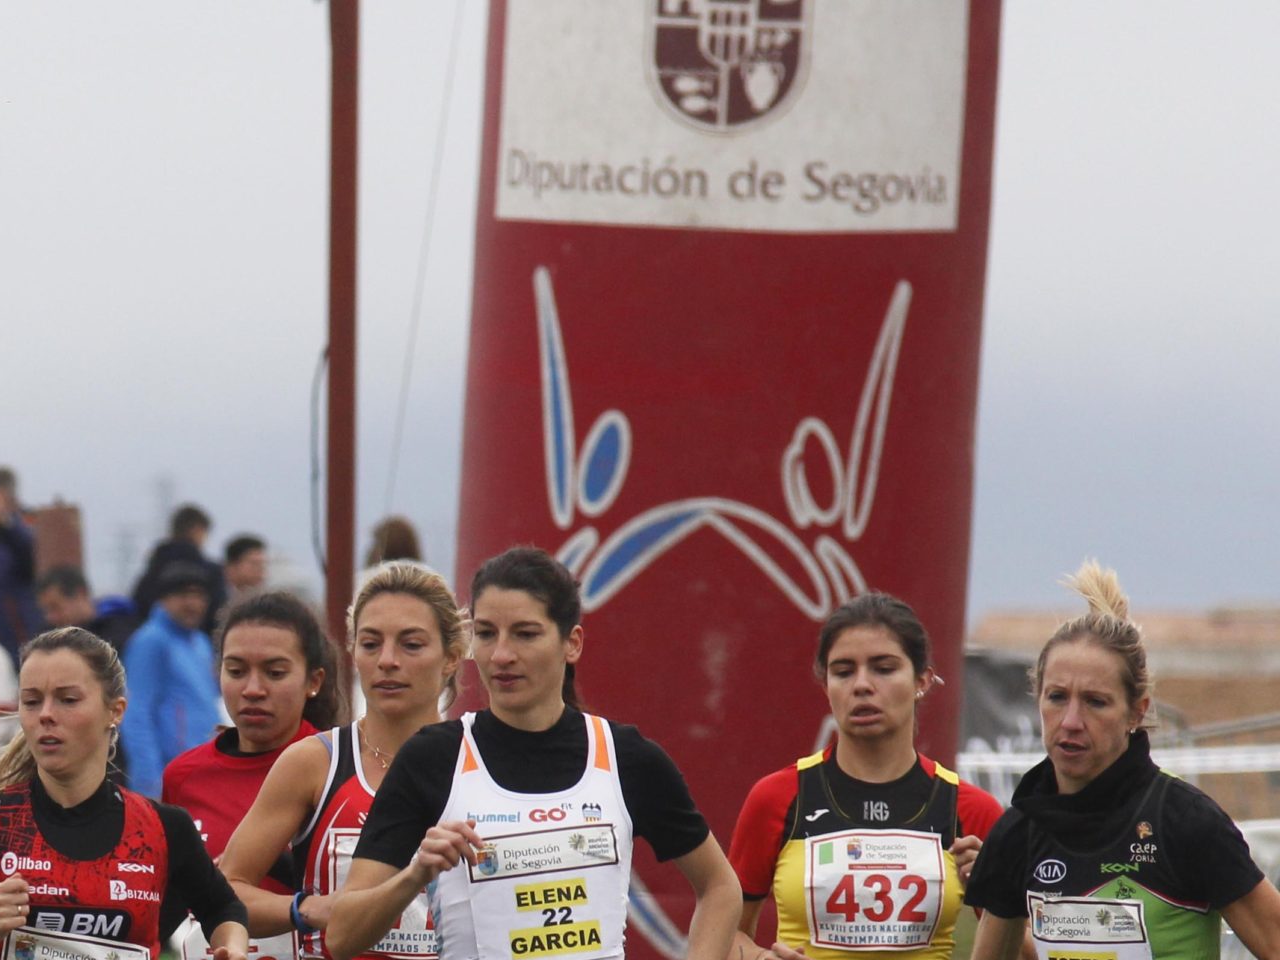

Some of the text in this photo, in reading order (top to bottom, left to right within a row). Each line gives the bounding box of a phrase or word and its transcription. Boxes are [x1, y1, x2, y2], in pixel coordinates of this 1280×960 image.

[506, 149, 948, 214] Diputación de Segovia
[467, 802, 573, 823] hummel GO fit
[503, 844, 560, 860] Diputación
[865, 843, 907, 852] Diputación
[1, 852, 51, 875] Bilbao
[505, 857, 562, 871] de Segovia
[877, 852, 907, 860] Segovia
[1038, 864, 1062, 879] KIA
[515, 885, 588, 908] ELENA
[826, 874, 928, 923] 432
[69, 913, 124, 937] BM
[541, 906, 574, 928] 22
[1042, 914, 1090, 925] Diputación
[819, 924, 846, 932] XLVIII
[848, 924, 877, 932] CROSS
[1043, 927, 1091, 938] de Segovia
[511, 928, 602, 955] GARCIA
[828, 934, 899, 944] CANTIMPALOS
